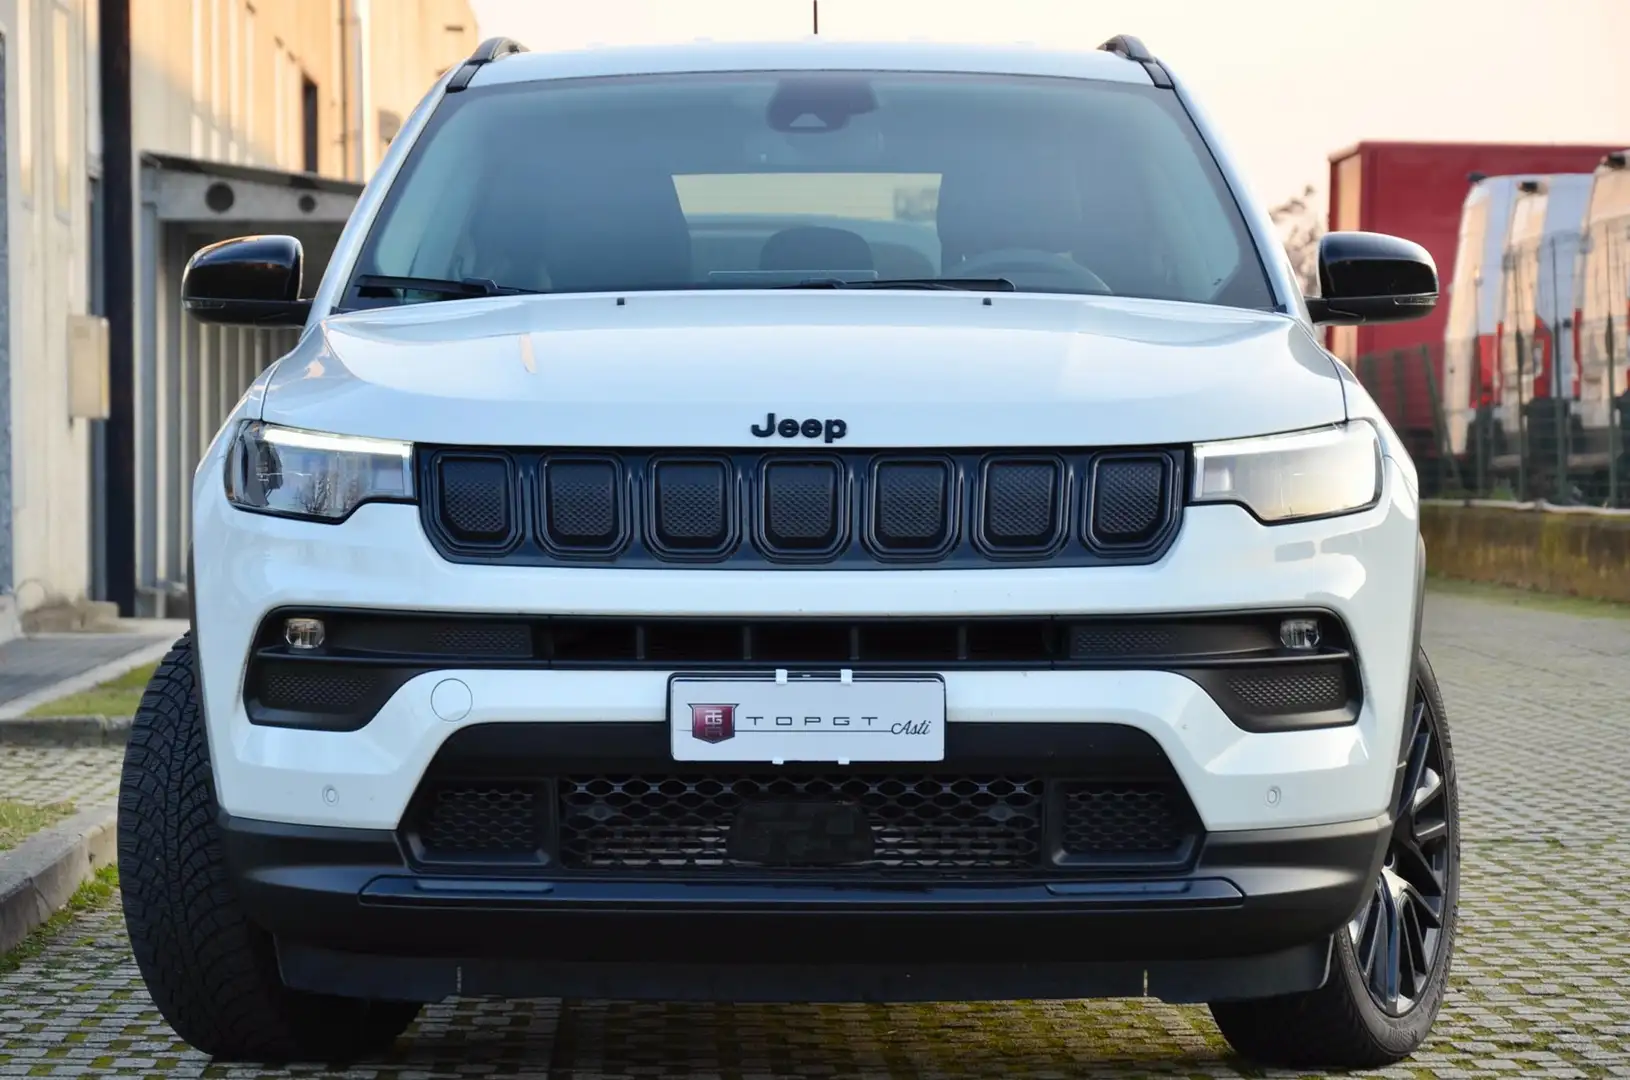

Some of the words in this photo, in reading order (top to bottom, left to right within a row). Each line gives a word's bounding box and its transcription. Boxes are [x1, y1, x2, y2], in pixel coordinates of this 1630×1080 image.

[751, 412, 847, 443] Jeep
[745, 716, 878, 726] TOPGT
[890, 719, 931, 735] Asti
